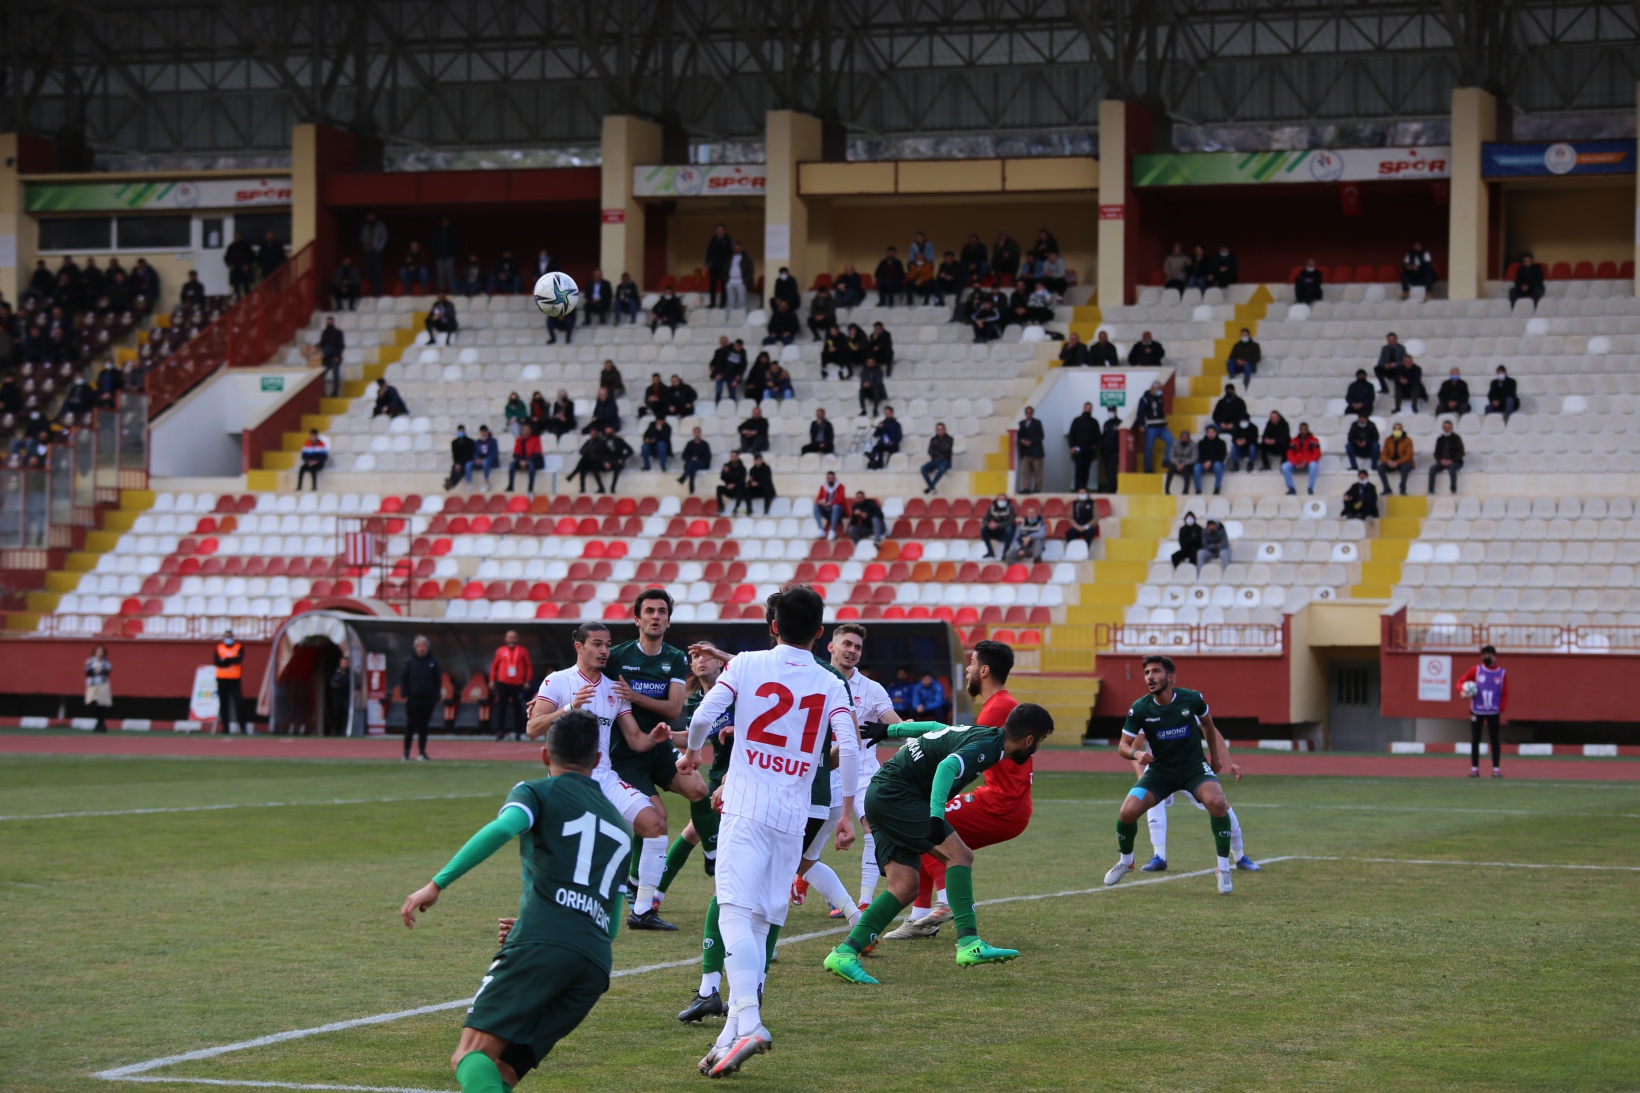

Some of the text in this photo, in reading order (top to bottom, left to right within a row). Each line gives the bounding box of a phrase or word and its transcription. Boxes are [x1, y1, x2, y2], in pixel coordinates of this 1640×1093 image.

[1377, 159, 1447, 174] SPOR
[642, 682, 666, 690] MONO
[746, 681, 827, 755] 21
[1165, 727, 1187, 736] MONO
[745, 749, 811, 778] YUSUF
[561, 810, 632, 900] 17
